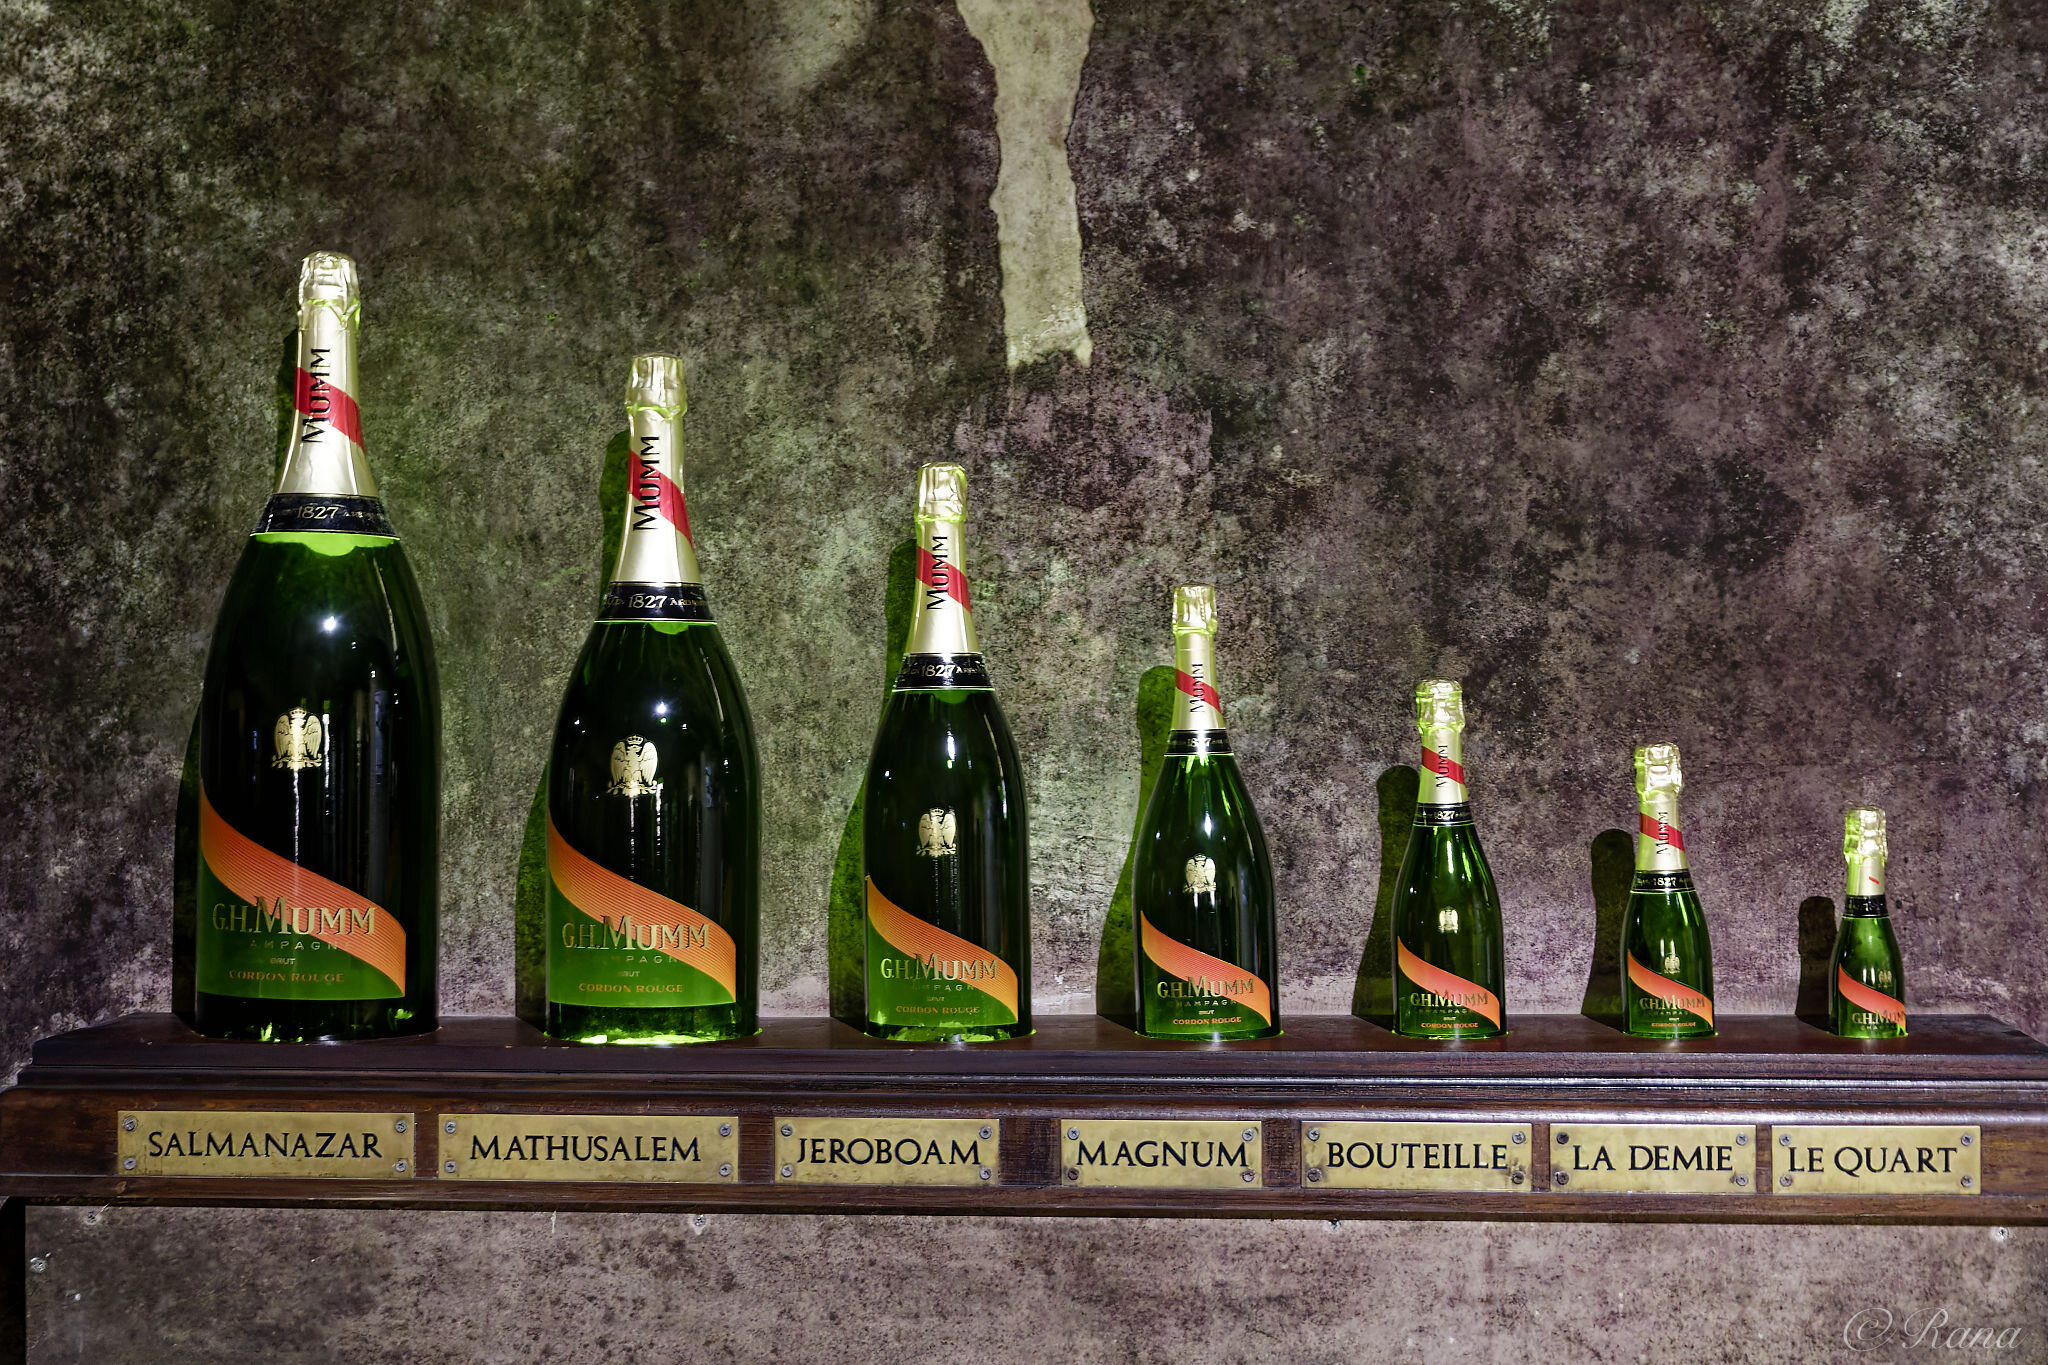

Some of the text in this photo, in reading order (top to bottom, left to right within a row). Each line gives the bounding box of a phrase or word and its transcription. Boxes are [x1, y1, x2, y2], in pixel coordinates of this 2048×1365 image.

[301, 348, 331, 443] MUMM
[633, 436, 661, 531] MUMM
[297, 505, 339, 520] 1827
[926, 536, 950, 610] MUMM
[628, 595, 668, 609] 1827
[921, 664, 956, 677] 1827
[1189, 663, 1206, 713] MUMM
[1187, 737, 1213, 749] 187
[1435, 745, 1450, 788] MUMM
[229, 970, 345, 983] CORDON ROUGE
[578, 983, 685, 993] CORDON ROUGE
[147, 1131, 384, 1159] SALMANAZAR
[469, 1134, 702, 1163] MATHUSALEM
[796, 1137, 983, 1166] JEROBOAM
[1076, 1140, 1249, 1168] MAGNUM
[1326, 1141, 1509, 1170] BOUTEILLE
[1572, 1144, 1734, 1173] LA DEMIE
[1787, 1146, 1959, 1178] LE QUART
